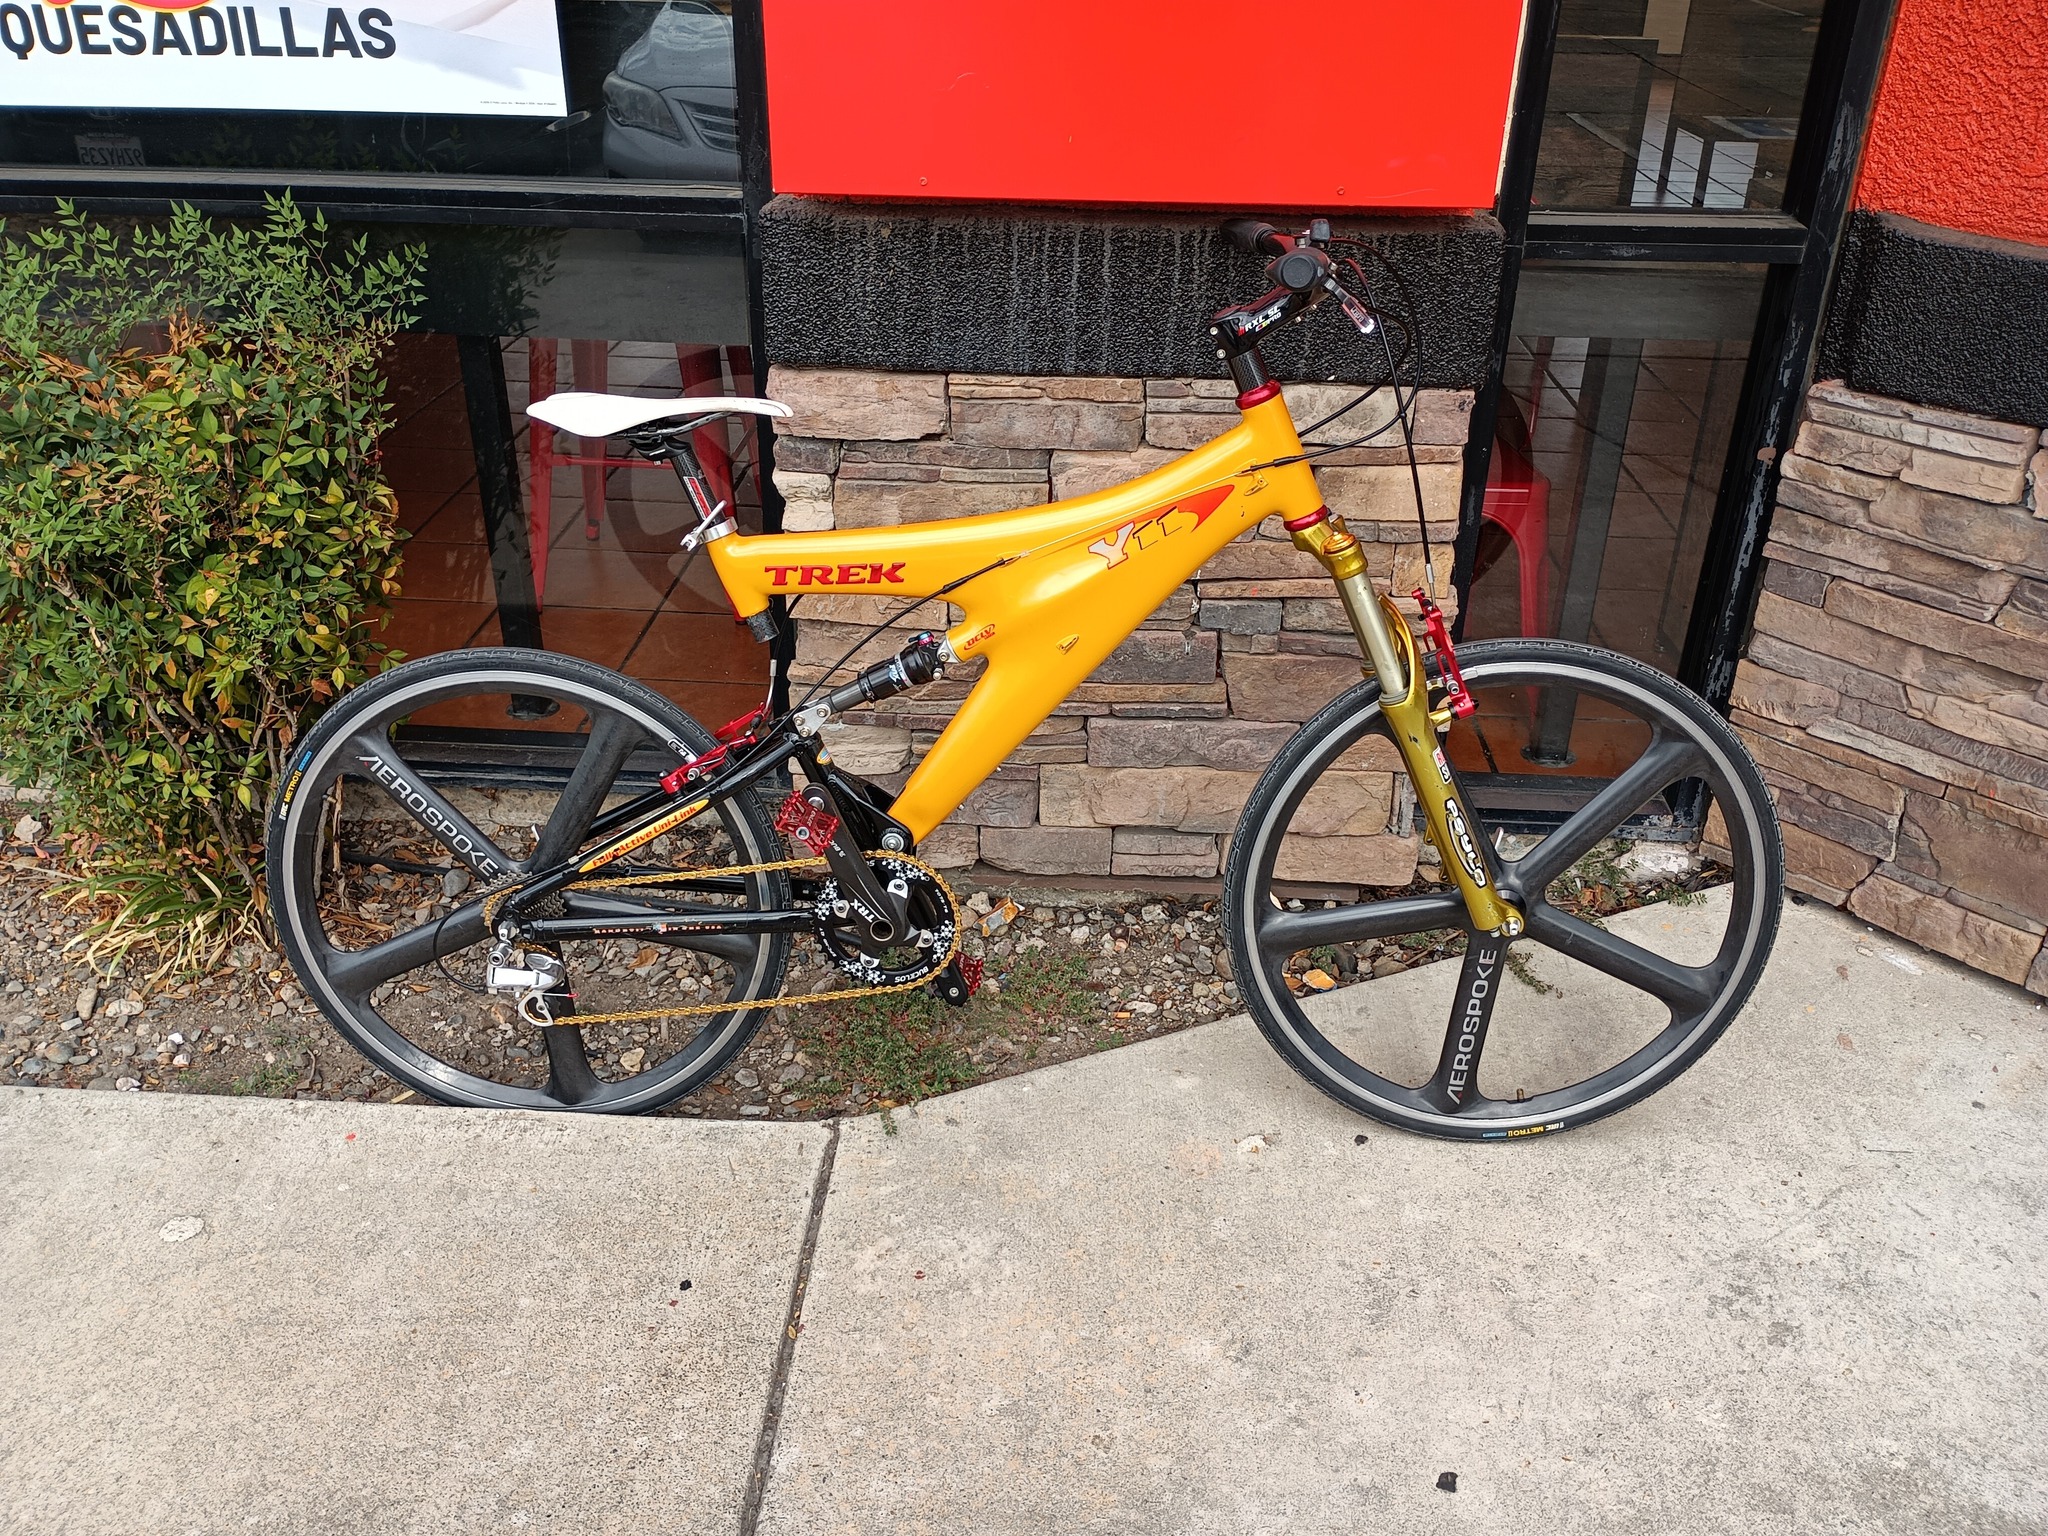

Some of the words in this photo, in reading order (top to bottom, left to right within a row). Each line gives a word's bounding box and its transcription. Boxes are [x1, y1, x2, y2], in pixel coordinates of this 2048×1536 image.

[0, 3, 397, 60] QUESADILLAS
[1244, 315, 1265, 332] RXL
[1267, 305, 1281, 317] SL
[765, 562, 906, 586] TREK
[355, 755, 499, 877] AEROSPOKE
[618, 830, 653, 854] Active
[653, 806, 697, 834] Uni-Link
[1445, 797, 1487, 889] PSYLO
[850, 899, 875, 923] TRX
[1446, 948, 1498, 1105] AEROSPOKE
